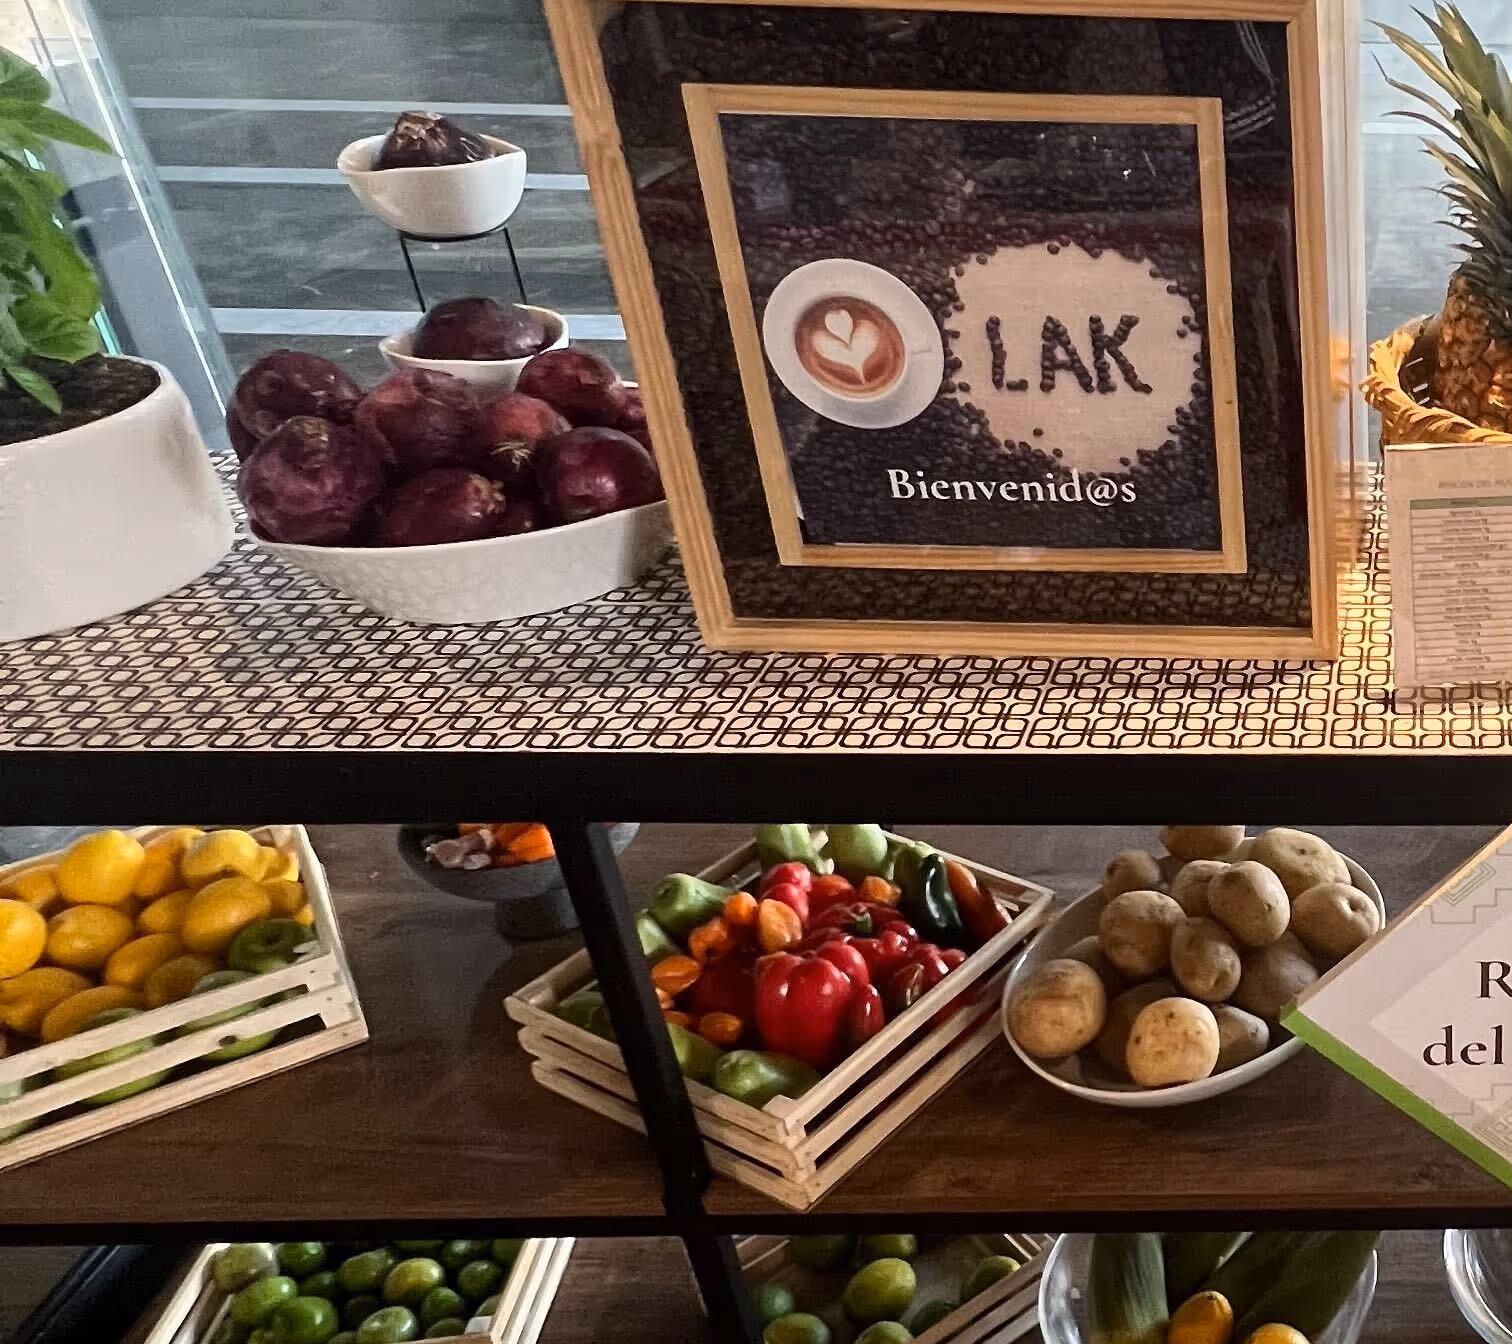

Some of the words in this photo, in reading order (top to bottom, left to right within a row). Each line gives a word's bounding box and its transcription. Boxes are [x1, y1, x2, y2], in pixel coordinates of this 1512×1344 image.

[986, 315, 1153, 393] LAK
[888, 468, 1137, 506] Bienvenid@s
[1422, 1025, 1504, 1067] del
